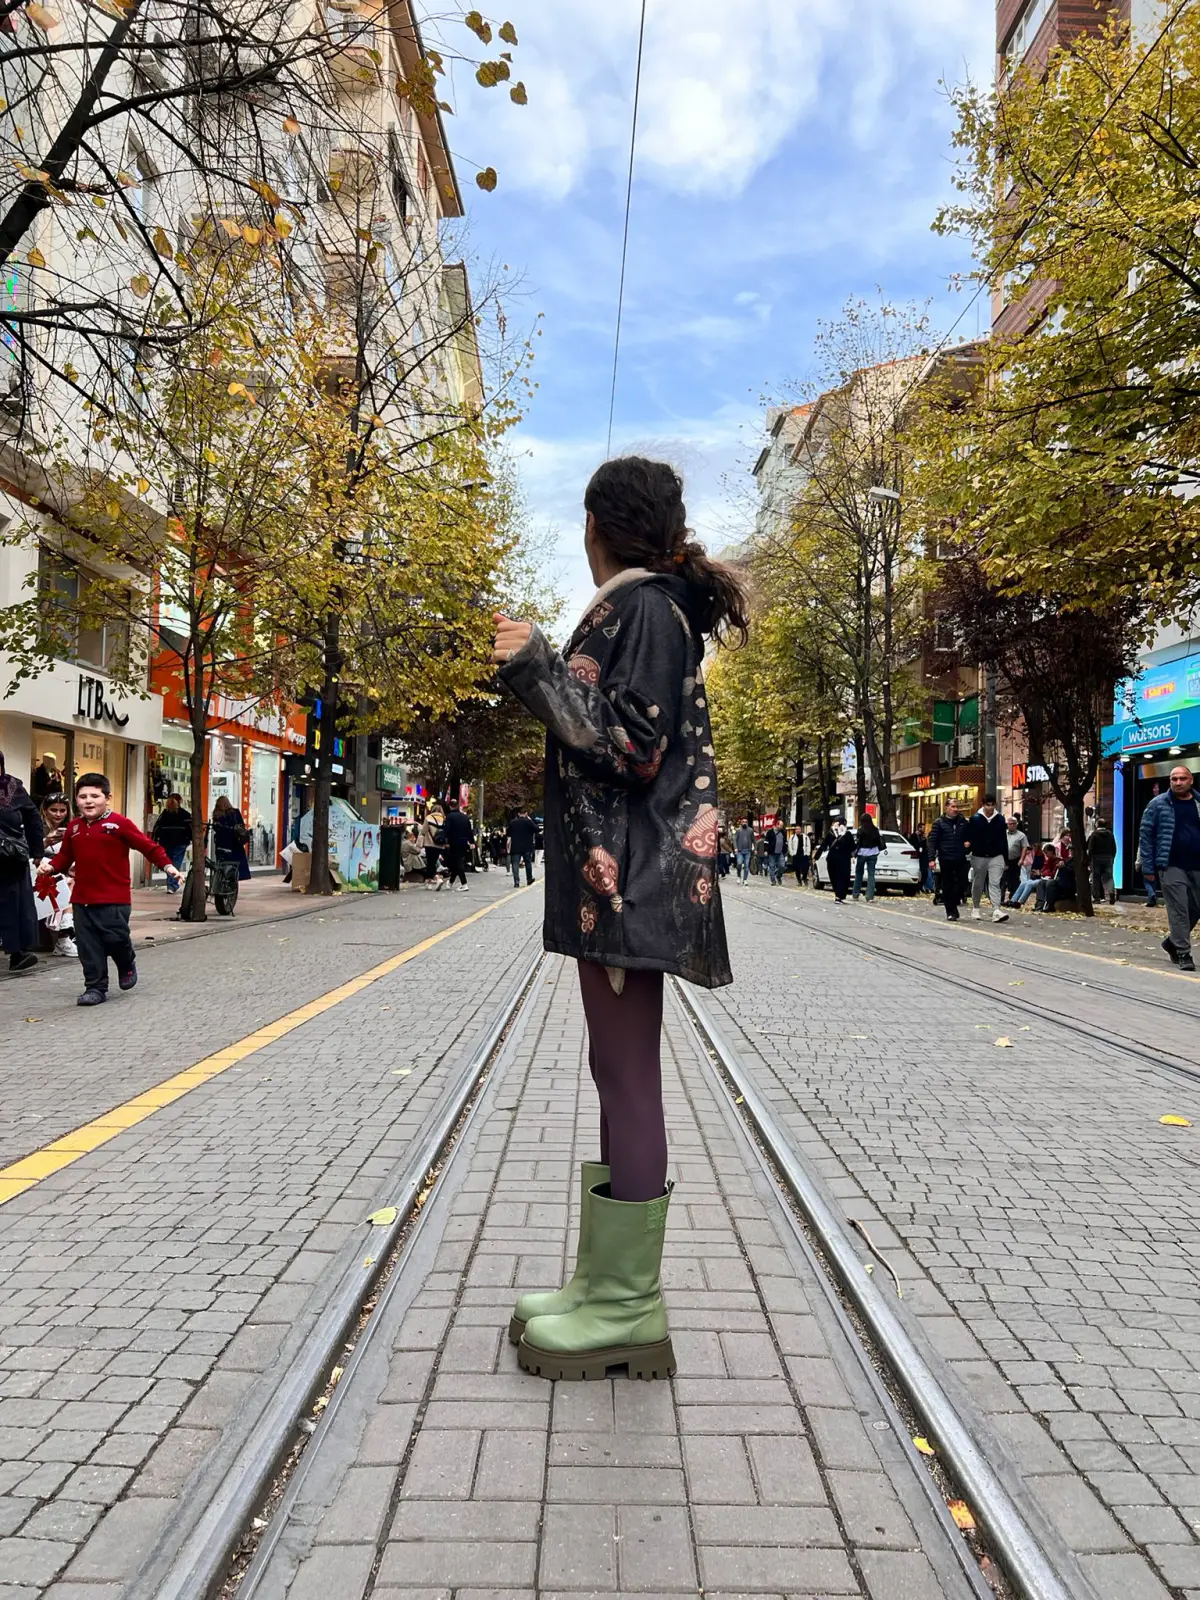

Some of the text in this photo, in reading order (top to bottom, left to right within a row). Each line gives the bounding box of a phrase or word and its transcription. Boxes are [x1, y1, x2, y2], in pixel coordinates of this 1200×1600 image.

[78, 674, 104, 720] LTB
[1128, 723, 1172, 743] watsons
[83, 742, 103, 760] LTB
